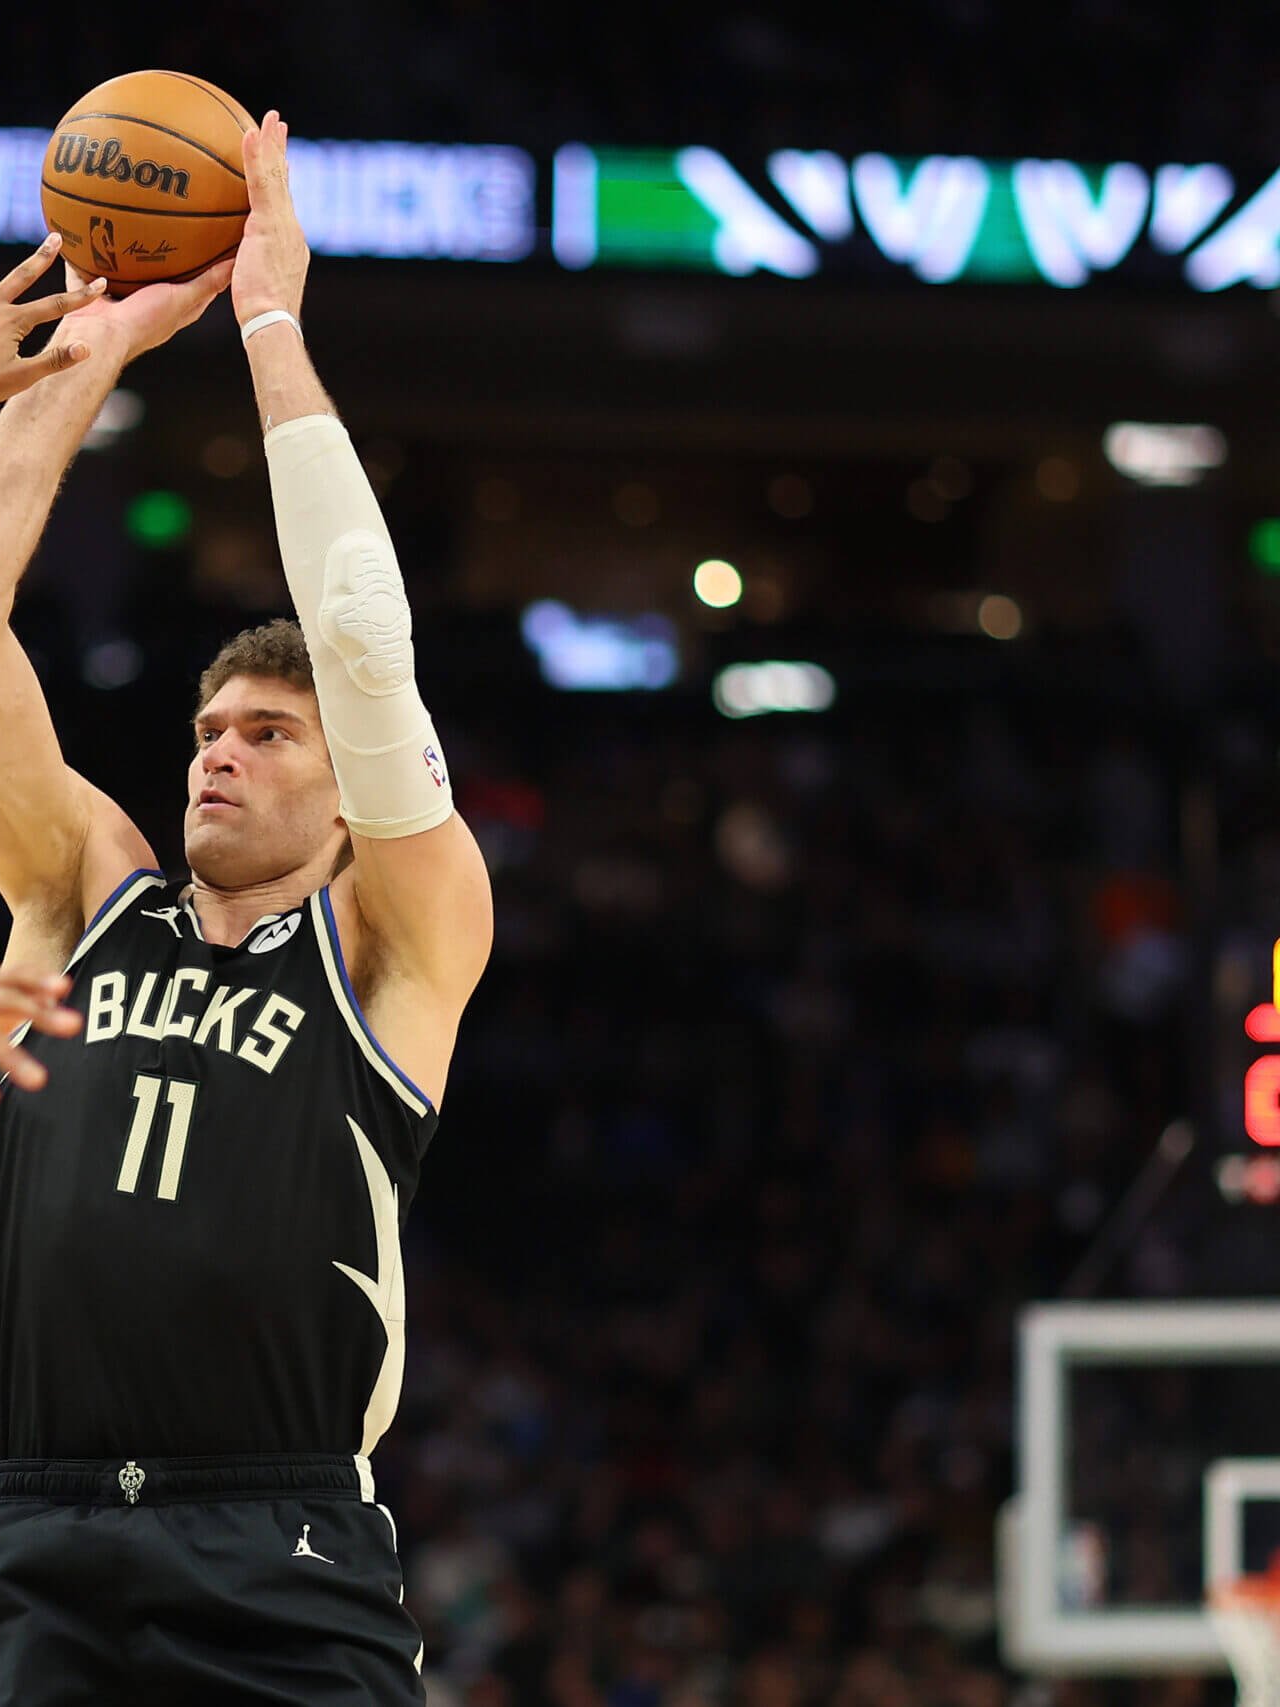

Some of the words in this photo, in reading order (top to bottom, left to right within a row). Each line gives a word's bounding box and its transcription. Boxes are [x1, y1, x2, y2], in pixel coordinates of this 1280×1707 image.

[53, 133, 191, 199] Wilson
[86, 968, 306, 1075] BUCKS
[115, 1074, 198, 1201] 11
